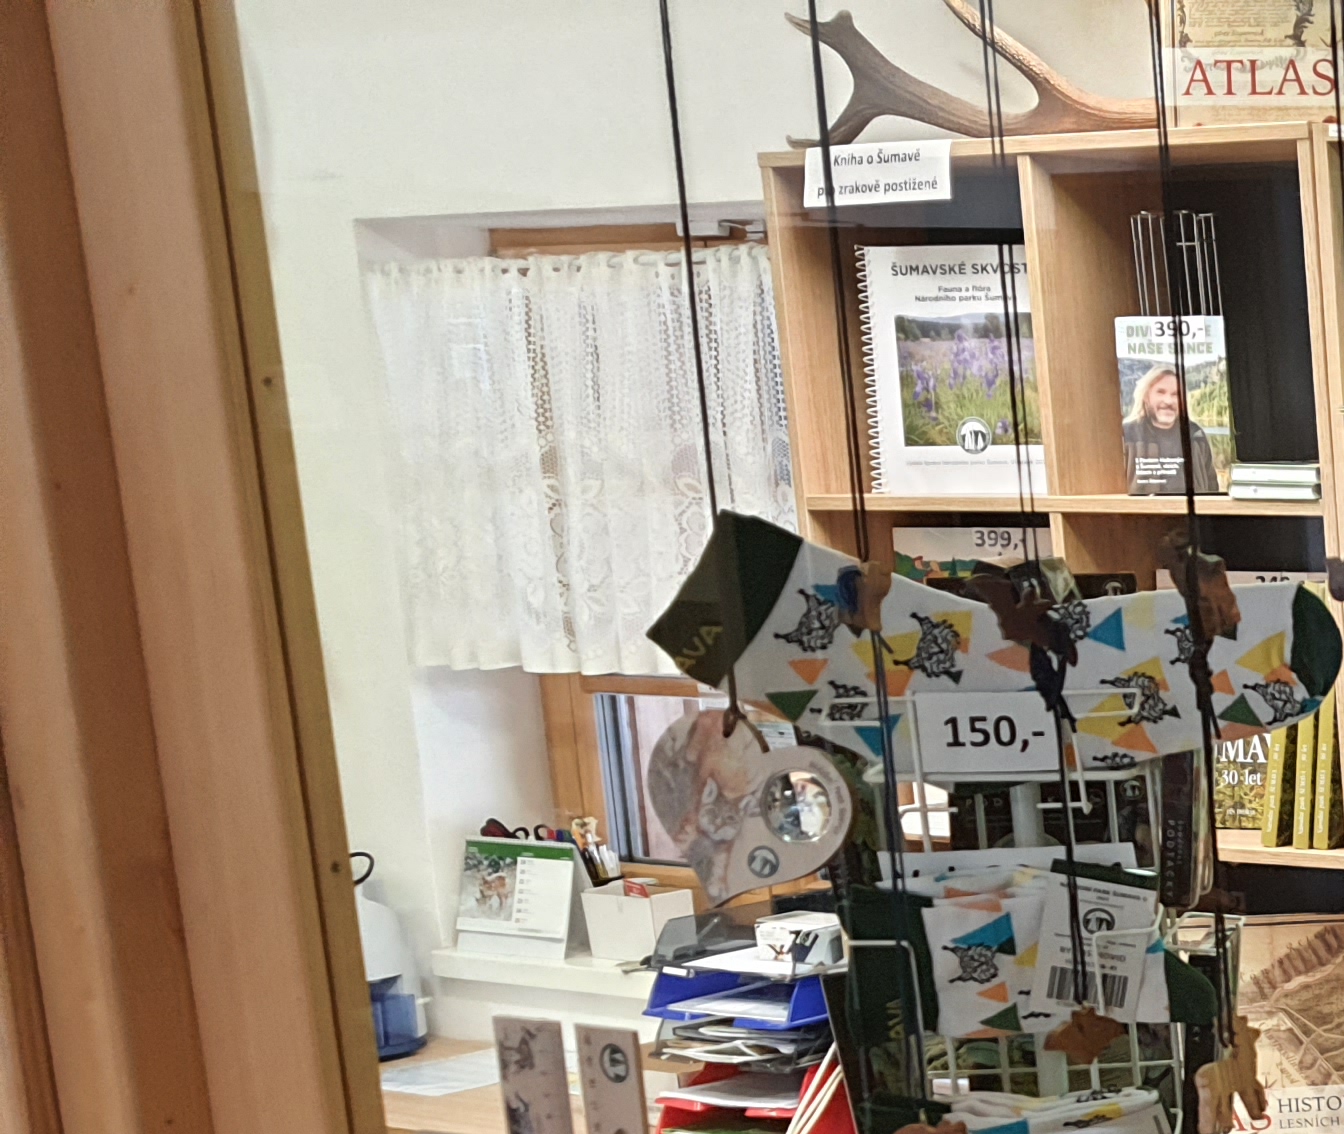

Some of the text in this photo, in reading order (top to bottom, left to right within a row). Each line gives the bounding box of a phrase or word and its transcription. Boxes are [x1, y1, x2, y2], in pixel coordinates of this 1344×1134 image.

[1182, 58, 1337, 97] ATLAS
[833, 148, 921, 168] Kniha Šumavě
[838, 180, 881, 196] zrakově
[883, 178, 938, 196] postižené
[890, 261, 967, 277] ŠUMAVSKÉ
[943, 714, 1045, 753] 150,-
[1221, 768, 1263, 786] 30 let
[1278, 1113, 1341, 1130] LESNÍCH
